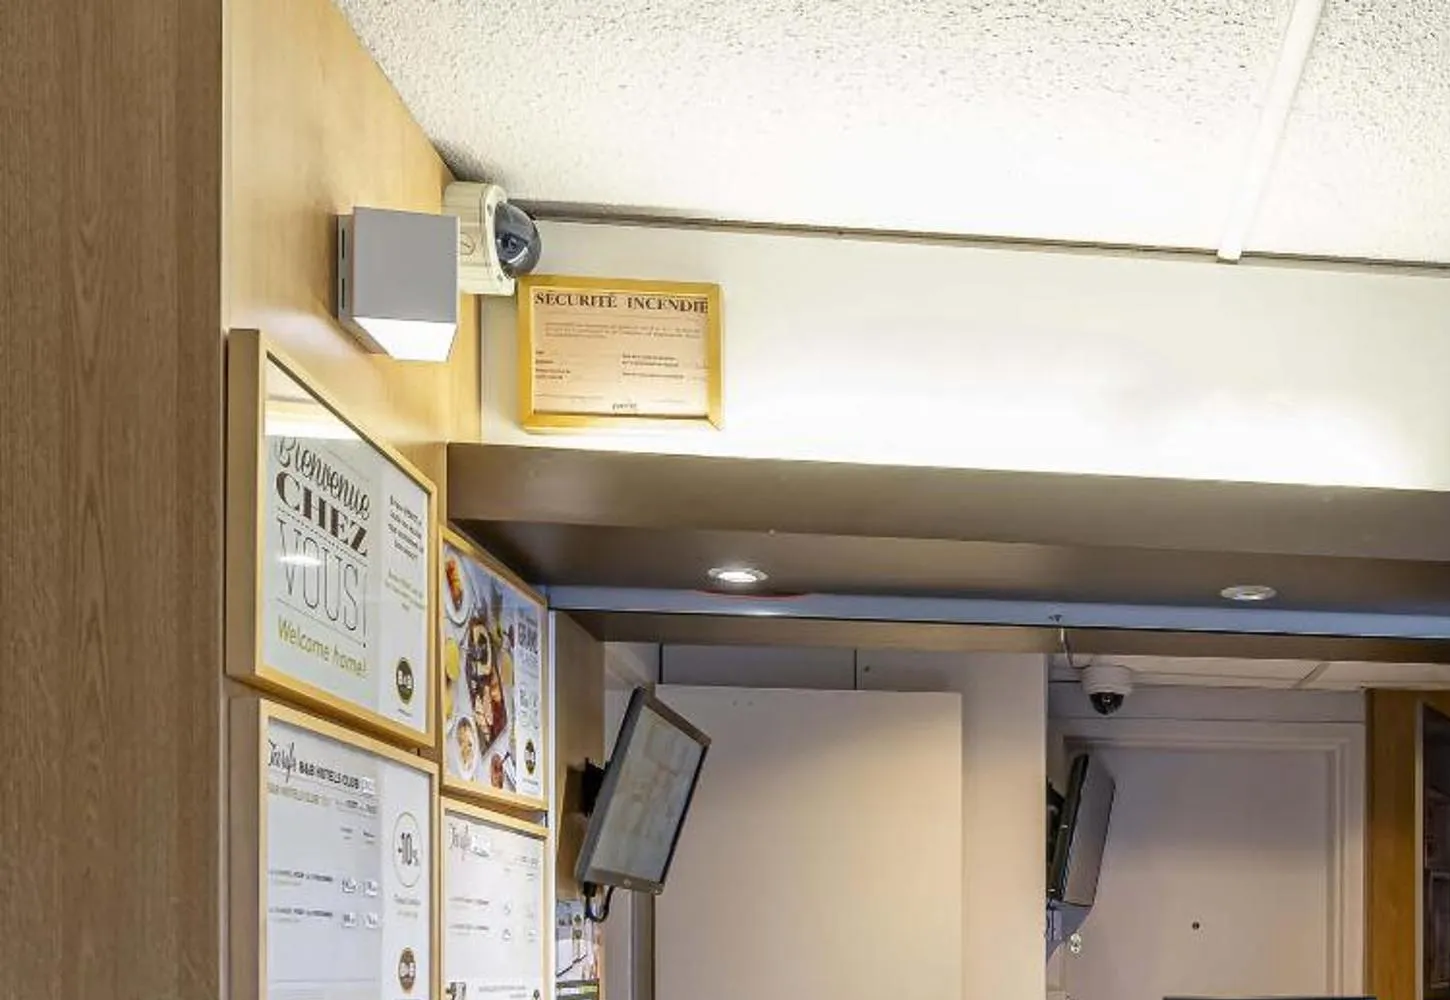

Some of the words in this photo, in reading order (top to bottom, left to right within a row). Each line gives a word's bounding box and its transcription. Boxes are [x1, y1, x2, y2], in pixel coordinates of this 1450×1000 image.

[627, 296, 708, 314] INCENDIE
[276, 471, 367, 556] CHEZ
[277, 613, 330, 661] Welcome
